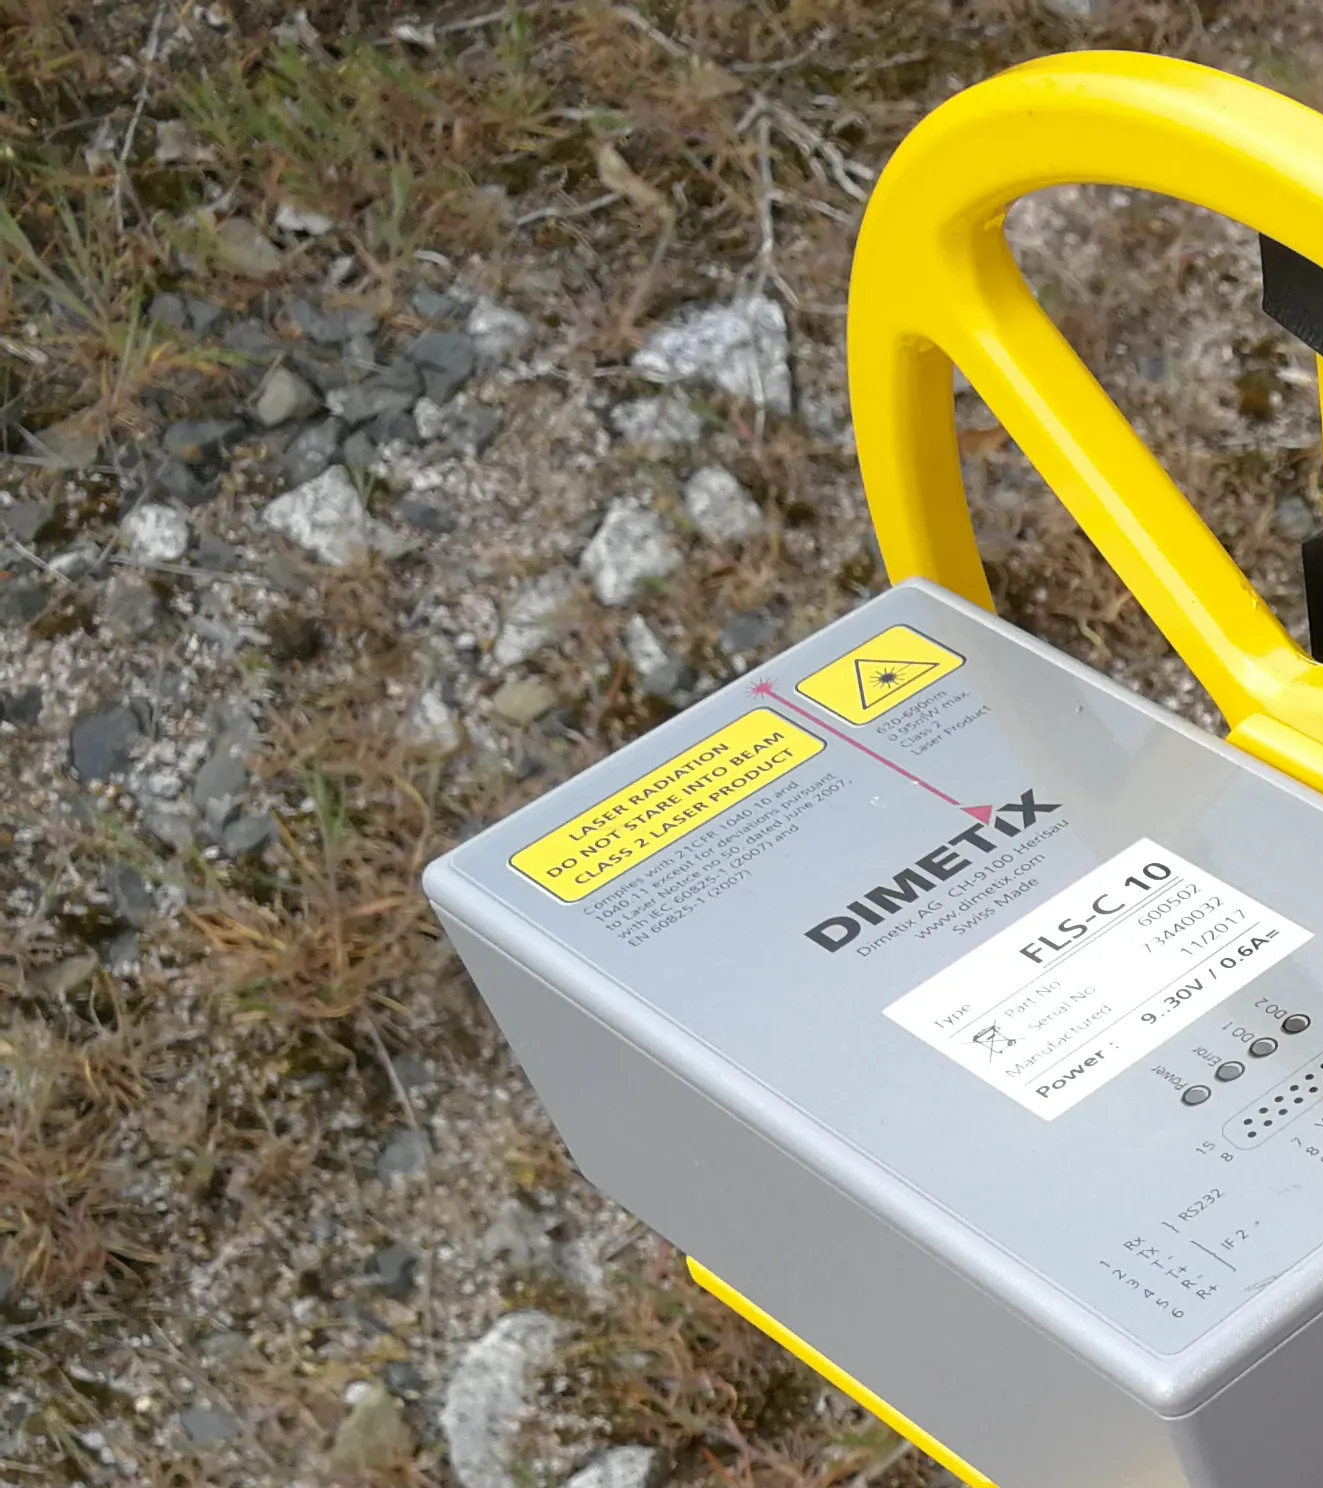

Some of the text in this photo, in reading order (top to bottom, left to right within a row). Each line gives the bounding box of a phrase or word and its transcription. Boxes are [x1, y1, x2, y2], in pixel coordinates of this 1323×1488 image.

[898, 727, 933, 748] Class
[909, 704, 992, 756] Laser Product
[545, 731, 785, 878] DO NOT STARE INTO BEAM
[568, 742, 729, 841] LASER RADIATION
[573, 747, 794, 885] CLASS 2 LASER PRODUCT
[650, 859, 695, 888] except
[693, 846, 715, 861] for
[715, 807, 780, 848] deviations
[778, 772, 836, 809] pursuant
[582, 876, 645, 916] Complies
[643, 857, 676, 878] with
[673, 829, 719, 859] 21CFR
[772, 780, 799, 798] and
[604, 919, 623, 931] to
[621, 897, 658, 921] Laser
[656, 871, 701, 899] Notice
[701, 858, 722, 871] no
[744, 818, 783, 845] dated
[616, 823, 800, 939] with IEC 60825-1 (2007) and
[855, 818, 1070, 957] Dimetix AG CH-9100 Herisau
[913, 853, 1046, 939] www.dimetix.com
[627, 868, 752, 947] EN 60825-1 (2007)
[951, 877, 1040, 935] Swiss Made
[1018, 860, 1173, 964] FLS-C 10
[1136, 883, 1199, 927] 600502
[1142, 895, 1223, 953] 73440032
[1179, 908, 1247, 956] 11/2017
[933, 1002, 973, 1029] Type
[1003, 979, 1062, 1018] Part No
[1027, 985, 1097, 1030] Serial No
[1139, 977, 1205, 1025] 9..30V
[1253, 996, 1288, 1019] DO 2
[1004, 1003, 1112, 1077] Manufactured
[1190, 1045, 1223, 1067] Error
[1230, 1026, 1256, 1043] DO
[1034, 1048, 1106, 1098] Power
[1149, 1064, 1189, 1091] Power
[1194, 1139, 1217, 1155] 15
[1218, 1151, 1235, 1162] 8
[1289, 1136, 1303, 1147] 7
[1304, 1145, 1320, 1156] 8
[1177, 1187, 1223, 1222] RS232
[1098, 1235, 1145, 1268] 1 Rx
[1111, 1245, 1159, 1280] 2 Tx
[1125, 1277, 1141, 1289] 3
[1141, 1264, 1188, 1299] 4 T+
[1154, 1297, 1170, 1309] 5
[1170, 1283, 1218, 1318] 6 R+
